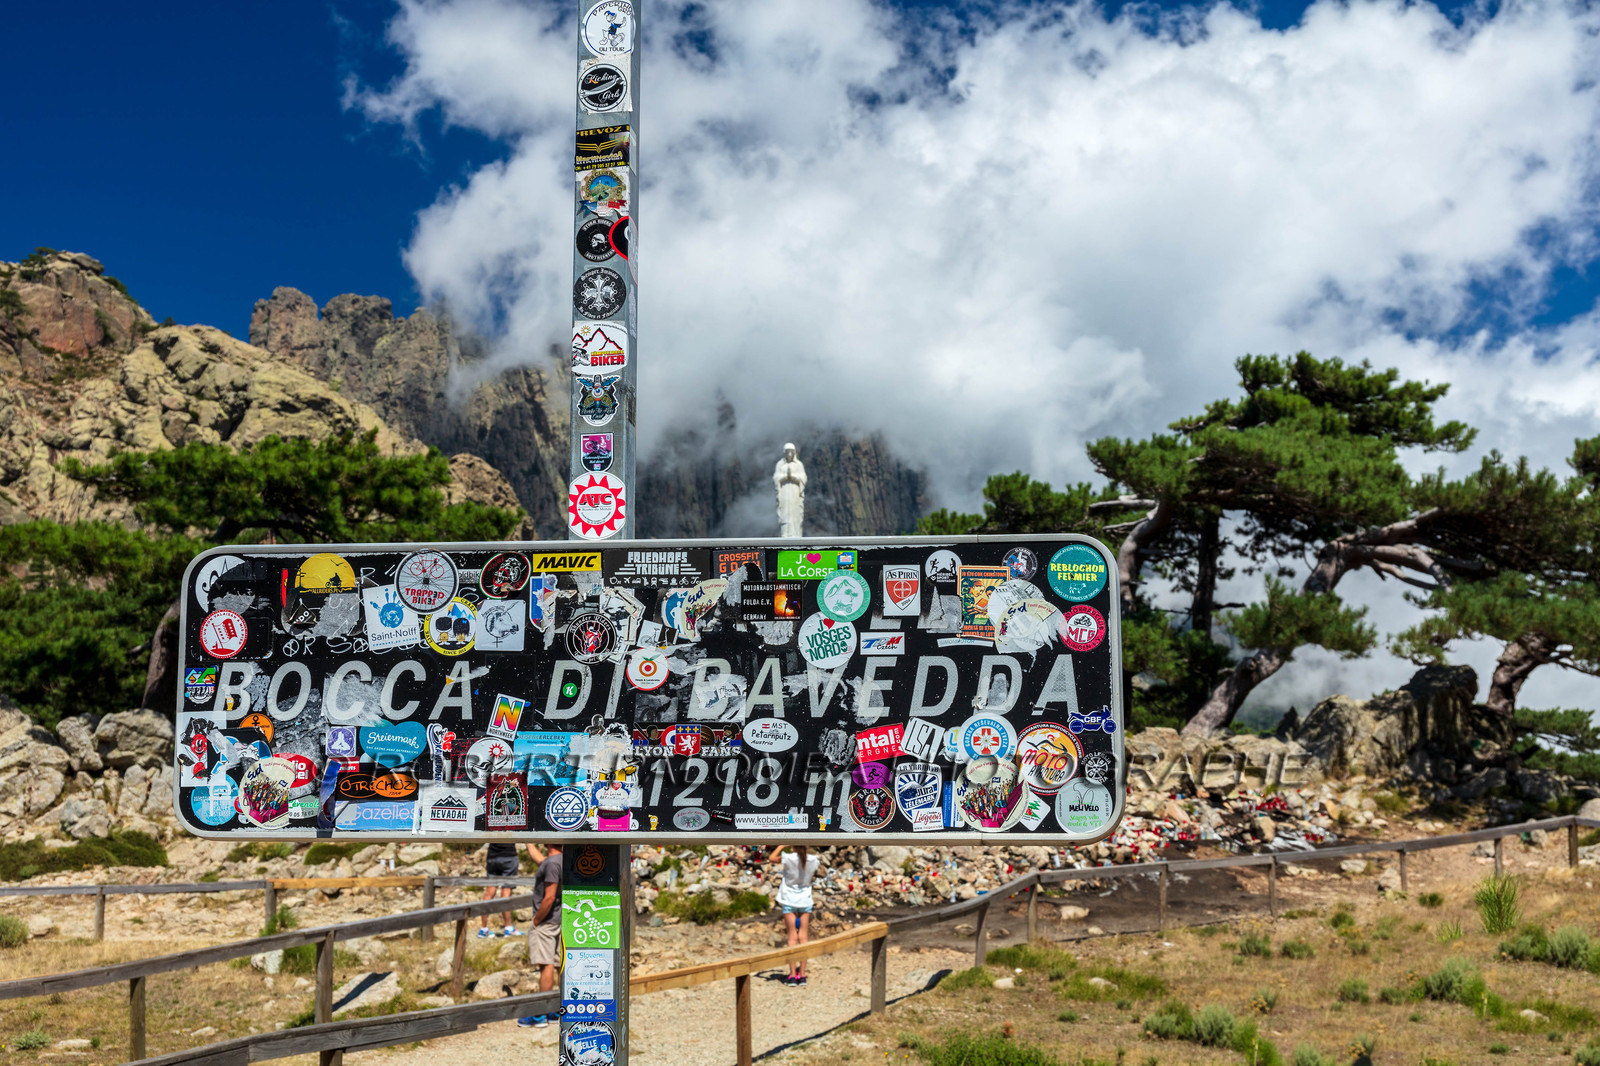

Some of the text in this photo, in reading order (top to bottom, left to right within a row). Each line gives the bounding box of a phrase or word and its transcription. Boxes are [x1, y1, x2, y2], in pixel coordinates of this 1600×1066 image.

[591, 355, 625, 367] BIKER
[579, 493, 612, 508] ATC
[628, 552, 688, 563] FRIEDHOFS
[719, 552, 760, 562] CROSSFIT
[1052, 546, 1074, 563] FABRICATION
[537, 556, 597, 568] MAVIC
[1050, 563, 1105, 573] REBLOCHON
[780, 568, 794, 577] LA
[743, 583, 801, 592] MOTORRADSTAMMTISCH
[371, 627, 417, 642] Saint-Nolff
[806, 626, 852, 648] VOSGES
[1068, 626, 1096, 643] MCG
[809, 642, 842, 661] NORD
[876, 642, 898, 650] Czech
[213, 660, 474, 722] BOCCA
[544, 660, 627, 720] DI
[751, 729, 791, 741] Petarnputz
[1017, 723, 1050, 741] OTOAVANTURA
[1049, 723, 1076, 742] MOTORCYCLE
[367, 731, 420, 749] Steiermark
[633, 745, 675, 757] LYON
[701, 745, 741, 757] FANS
[1022, 749, 1068, 770] MOTO
[1028, 764, 1066, 783] AVANTURA
[649, 757, 851, 807] 1218 m
[858, 788, 887, 800] BRAVE
[905, 794, 936, 809] TELEMARK
[430, 810, 468, 821] NEVADAH
[860, 816, 883, 826] RIDERS
